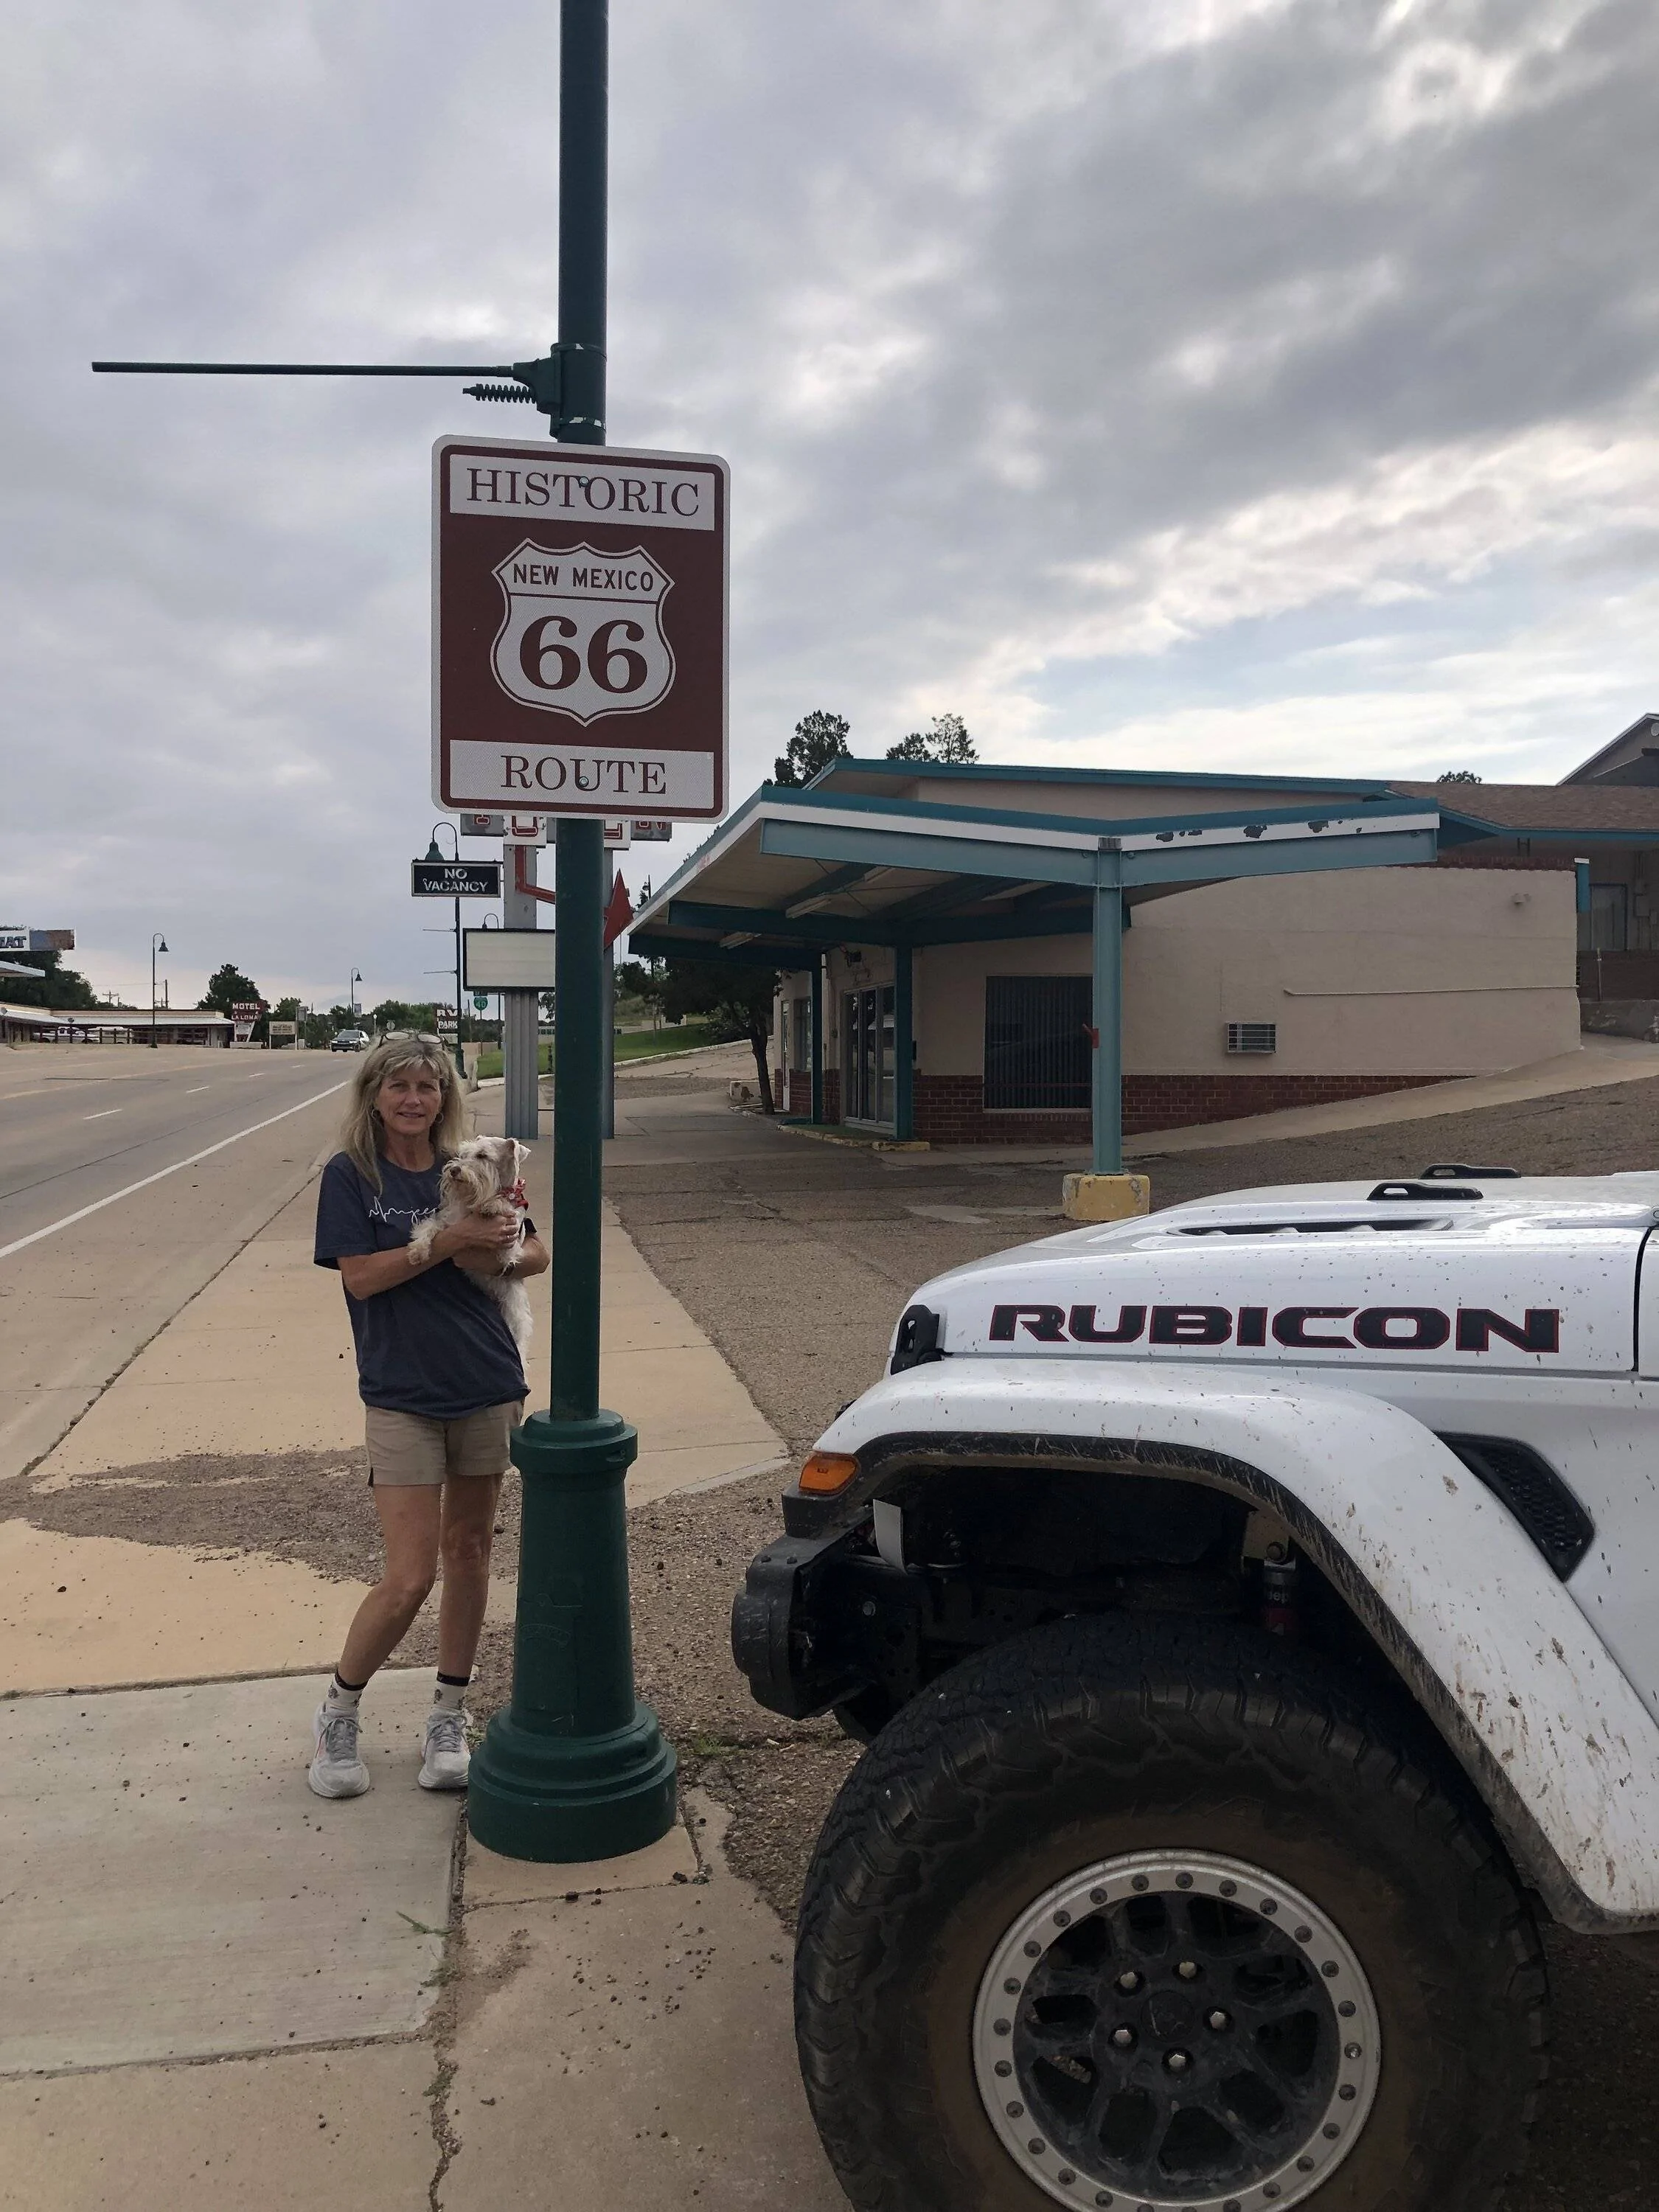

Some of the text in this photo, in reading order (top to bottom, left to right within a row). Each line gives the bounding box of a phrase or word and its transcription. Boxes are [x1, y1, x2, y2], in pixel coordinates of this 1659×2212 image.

[466, 467, 700, 517] HISTORIC
[512, 563, 654, 592] NEW MEXICO
[519, 615, 648, 694] 66
[501, 754, 667, 795] ROUTE
[423, 880, 488, 892] VACANCY
[445, 868, 467, 880] NO
[437, 1009, 458, 1017] RV
[438, 1021, 458, 1029] PARK
[988, 1304, 1560, 1354] RUBICON
